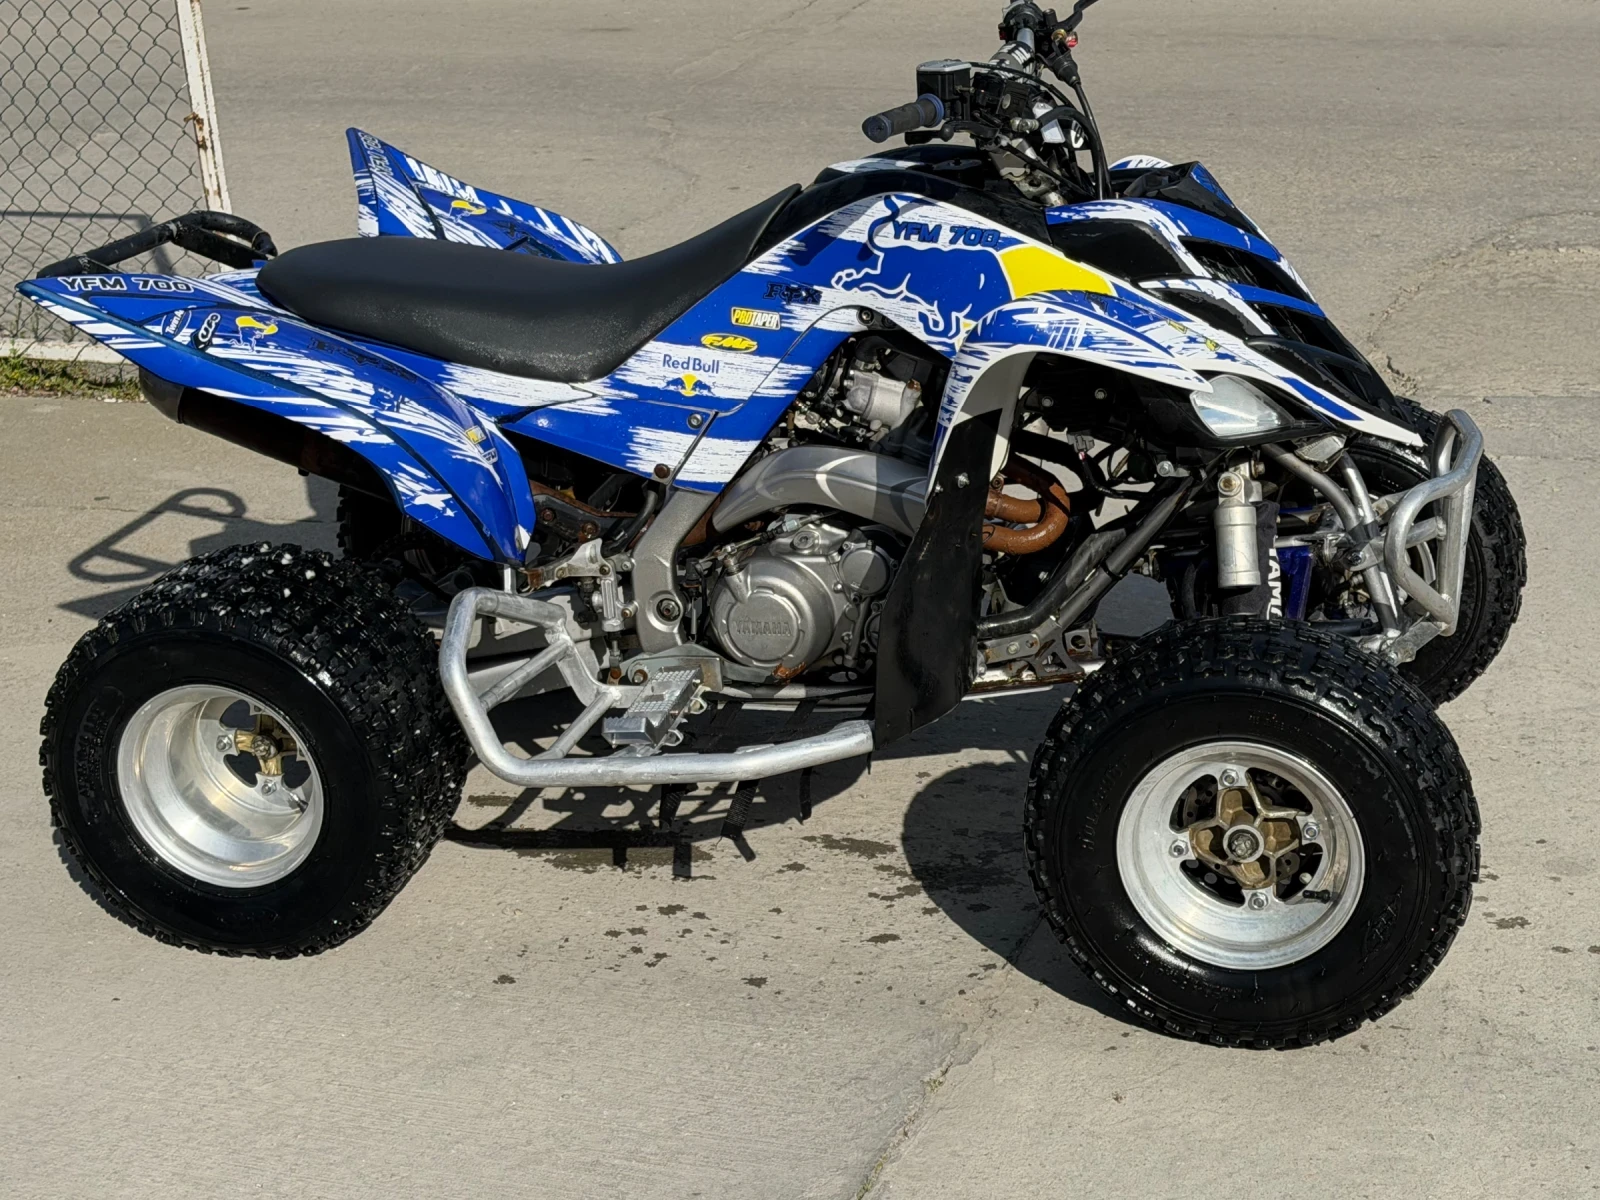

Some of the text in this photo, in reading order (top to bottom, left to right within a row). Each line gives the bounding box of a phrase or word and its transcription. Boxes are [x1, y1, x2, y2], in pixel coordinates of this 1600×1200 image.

[892, 220, 1001, 248] YFM 700
[58, 276, 195, 293] YFM 700
[763, 282, 823, 305] FOX
[733, 309, 778, 329] PROTAPER
[702, 335, 758, 351] FMF
[662, 353, 720, 374] Red Bull
[734, 620, 792, 636] YAMAHA
